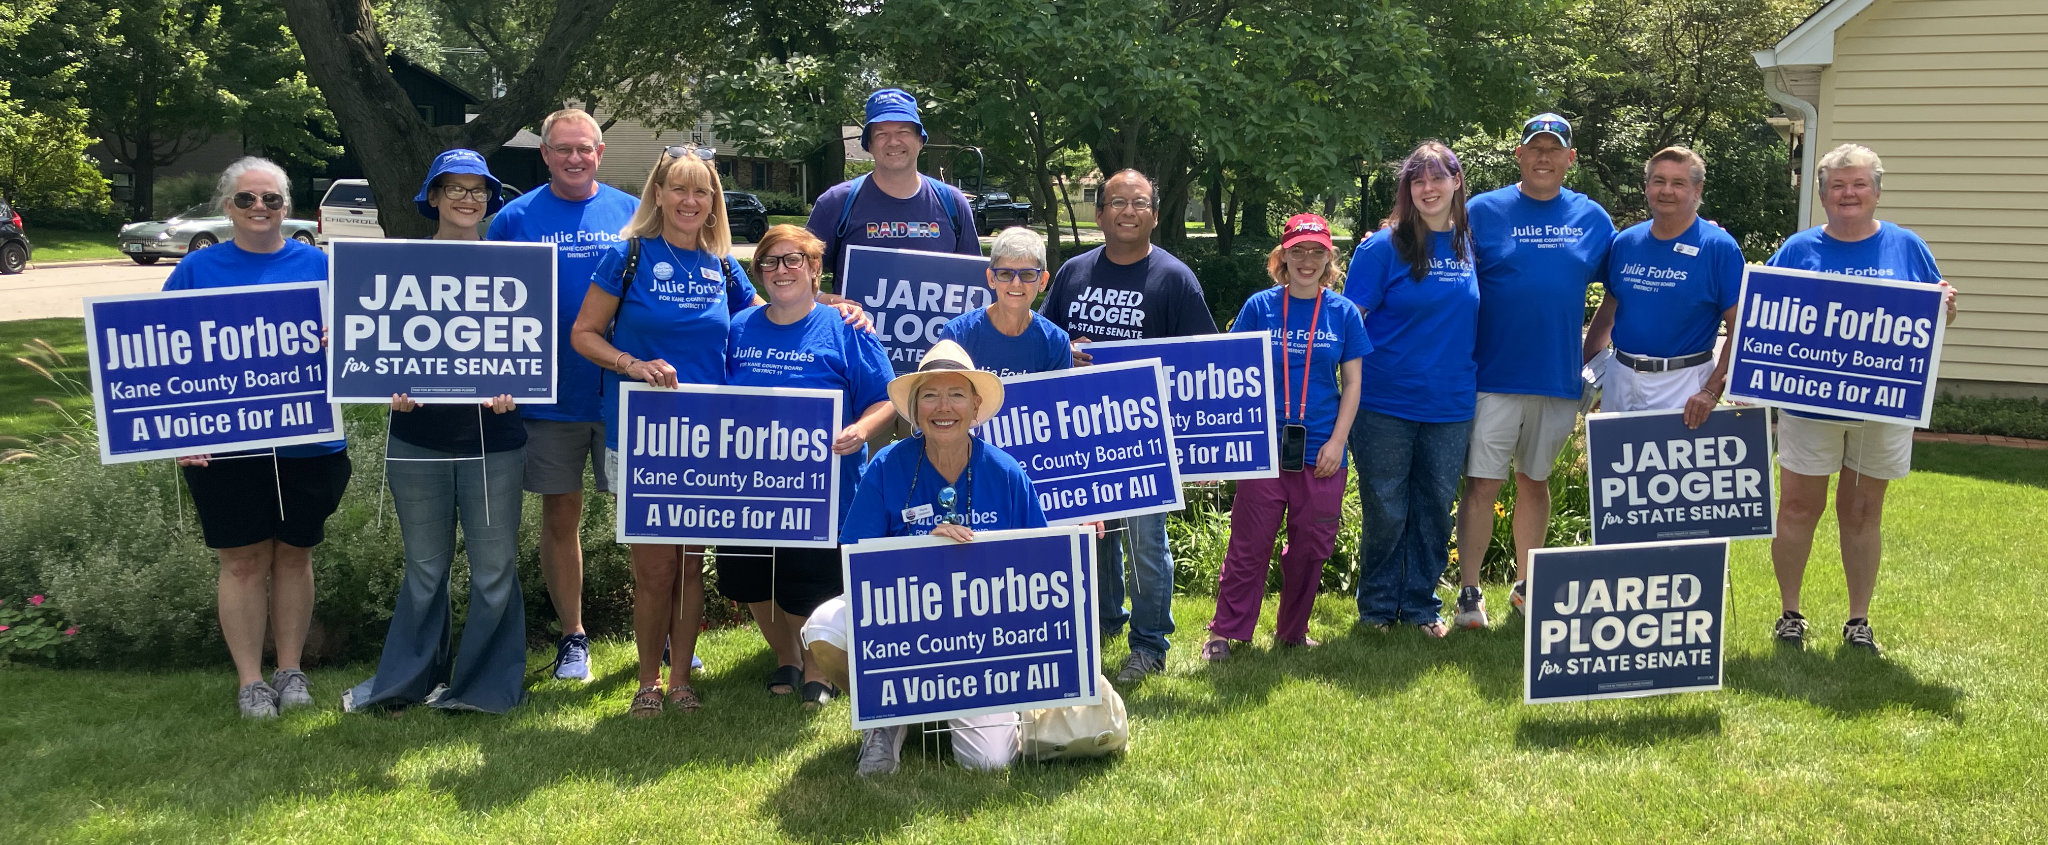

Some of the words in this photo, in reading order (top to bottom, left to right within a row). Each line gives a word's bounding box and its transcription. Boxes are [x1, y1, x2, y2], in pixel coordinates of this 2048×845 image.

[867, 222, 940, 238] RAIDERS
[1511, 225, 1542, 236] Julie
[1545, 224, 1584, 236] Forbes
[650, 279, 685, 294] Julie
[1620, 264, 1646, 276] Julie
[1647, 266, 1688, 280] Forbes
[1846, 266, 1894, 276] Forbes
[359, 274, 528, 312] JARED
[864, 278, 992, 314] JARED
[1078, 286, 1143, 307] JARED
[344, 314, 542, 352] PLOGER
[862, 311, 949, 344] LOG
[1068, 302, 1145, 328] PLOGER
[1078, 322, 1106, 334] STATE
[1106, 327, 1142, 340] SENATE
[1746, 293, 1818, 335] Julie
[1824, 301, 1932, 348] Forbes
[106, 324, 192, 370] Julie
[200, 316, 320, 362] Forbes
[733, 346, 762, 358] Julie
[766, 348, 814, 362] Forbes
[884, 347, 925, 362] TATE
[1744, 337, 1782, 356] Kane
[1788, 343, 1848, 368] County
[1852, 350, 1904, 371] Board
[1909, 358, 1924, 374] 11
[111, 381, 161, 400] Kane
[168, 373, 238, 394] County
[245, 366, 300, 388] Board
[306, 364, 322, 382] 11
[342, 357, 370, 378] for
[375, 357, 448, 375] STATE
[454, 358, 542, 376] SENATE
[1163, 362, 1262, 402] Forbes
[1750, 369, 1764, 389] A
[1770, 371, 1832, 399] Voice
[1838, 380, 1871, 404] for
[1874, 386, 1907, 409] All
[132, 417, 150, 442] A
[155, 412, 232, 439] Voice
[238, 408, 274, 431] for
[281, 401, 314, 426] All
[1056, 395, 1159, 440] Forbes
[1196, 408, 1242, 426] Board
[1248, 406, 1262, 423] 11
[633, 416, 710, 459] Julie
[720, 418, 828, 462] Forbes
[1032, 449, 1090, 476] County
[1096, 441, 1143, 464] Board
[1148, 438, 1164, 456] 11
[1189, 444, 1220, 464] for
[1225, 440, 1252, 462] All
[1611, 435, 1748, 474] JARED
[634, 468, 678, 486] Kane
[684, 469, 748, 492] County
[753, 471, 804, 489] Board
[810, 472, 825, 490] 11
[1039, 488, 1088, 512] oice
[1092, 482, 1123, 505] for
[1129, 474, 1158, 499] All
[1600, 468, 1762, 508] PLOGER
[646, 504, 661, 526] A
[668, 504, 736, 528] Voice
[742, 506, 776, 530] for
[780, 508, 811, 530] All
[1601, 512, 1624, 530] for
[1628, 507, 1686, 525] STATE
[1690, 502, 1762, 521] SENATE
[860, 576, 942, 628] Julie
[952, 566, 1070, 618] Forbes
[1554, 574, 1702, 616] JARED
[863, 640, 910, 660] Kane
[916, 631, 986, 655] County
[992, 621, 1048, 646] Board
[1054, 620, 1070, 640] 11
[1540, 610, 1713, 655] PLOGER
[1537, 662, 1562, 680] for
[1566, 654, 1630, 676] STATE
[1634, 648, 1712, 670] SENATE
[881, 679, 898, 706] A
[902, 674, 978, 704] Voice
[984, 668, 1020, 695] for
[1027, 662, 1060, 690] All
